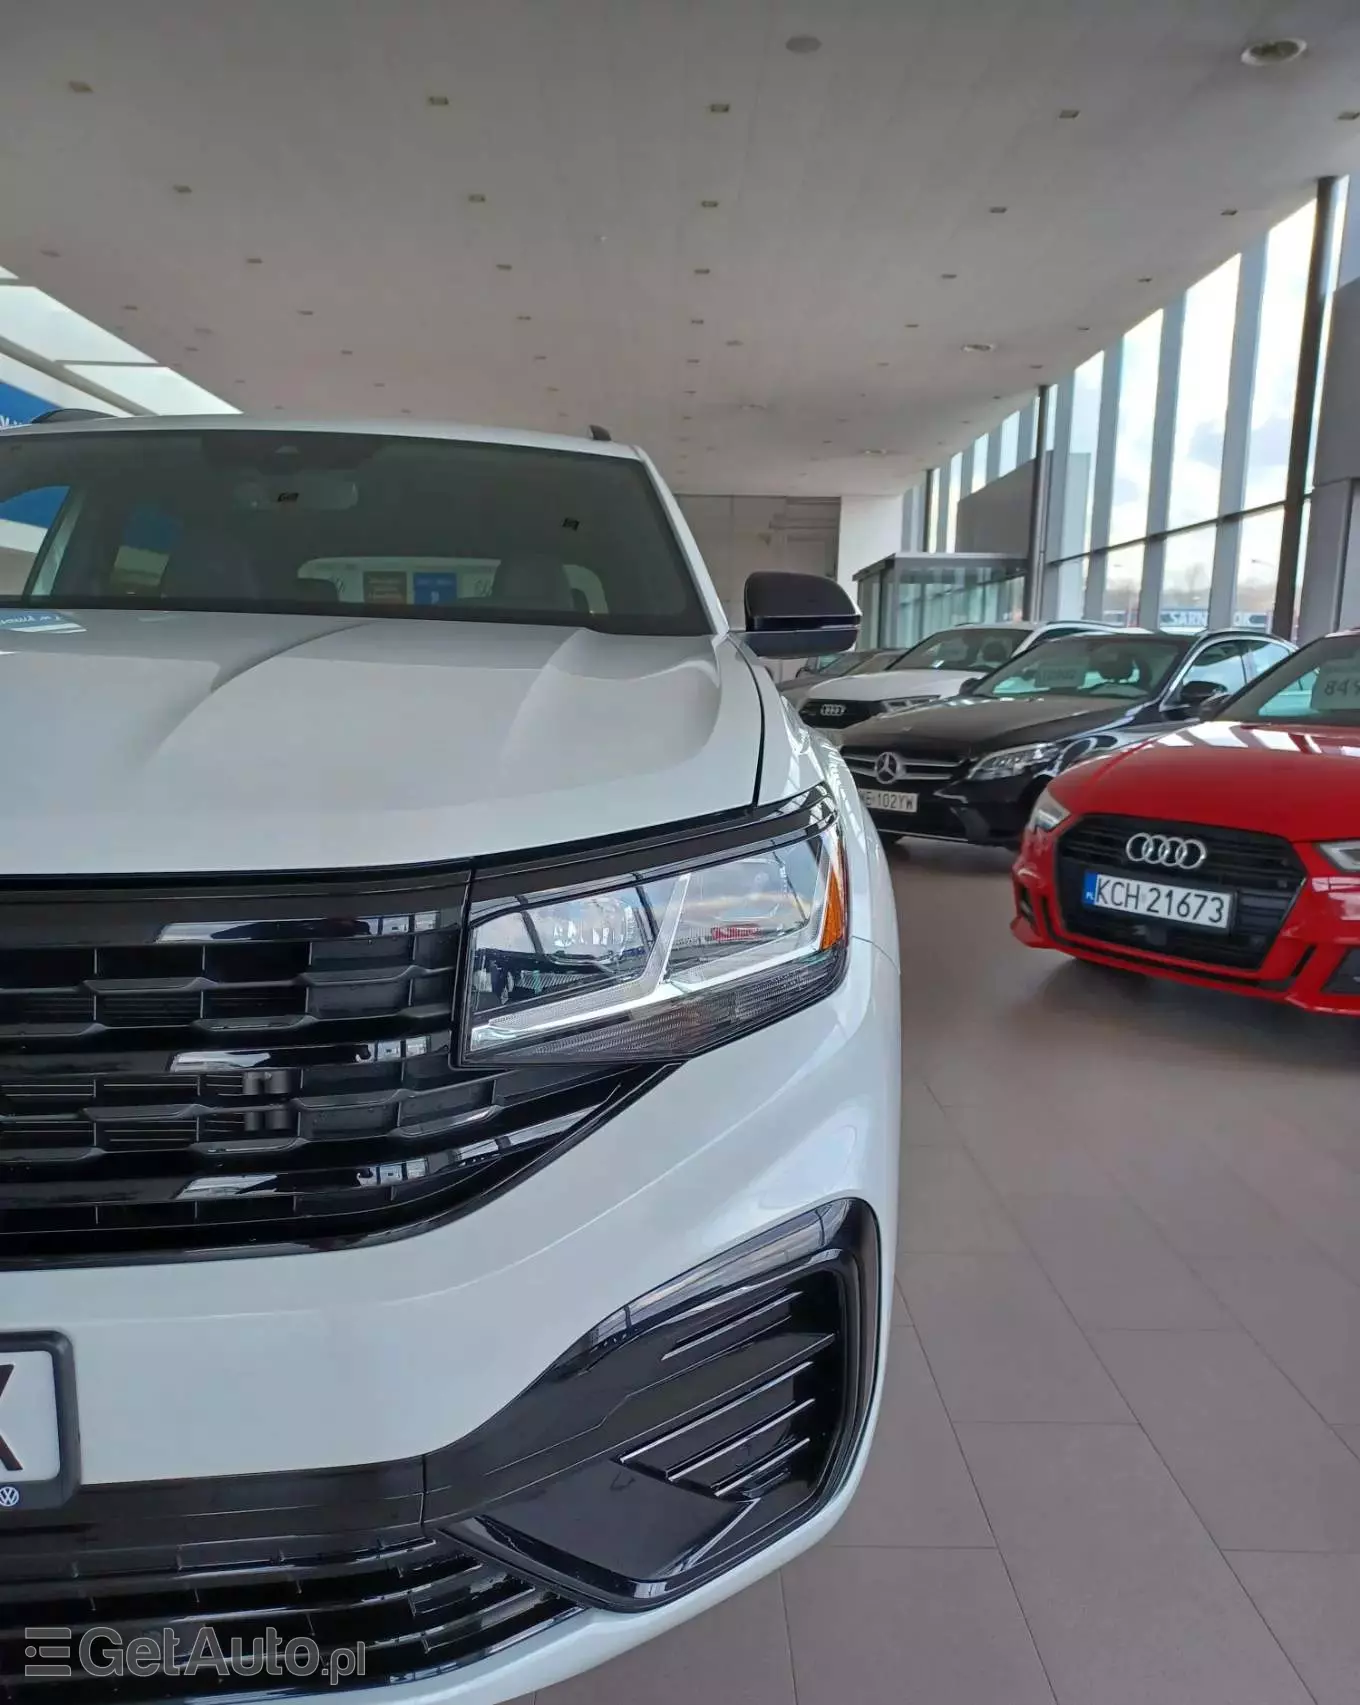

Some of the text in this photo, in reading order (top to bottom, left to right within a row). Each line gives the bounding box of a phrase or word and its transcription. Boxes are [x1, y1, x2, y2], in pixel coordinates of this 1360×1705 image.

[1170, 613, 1208, 626] SARN
[1096, 879, 1225, 923] KCH 21673
